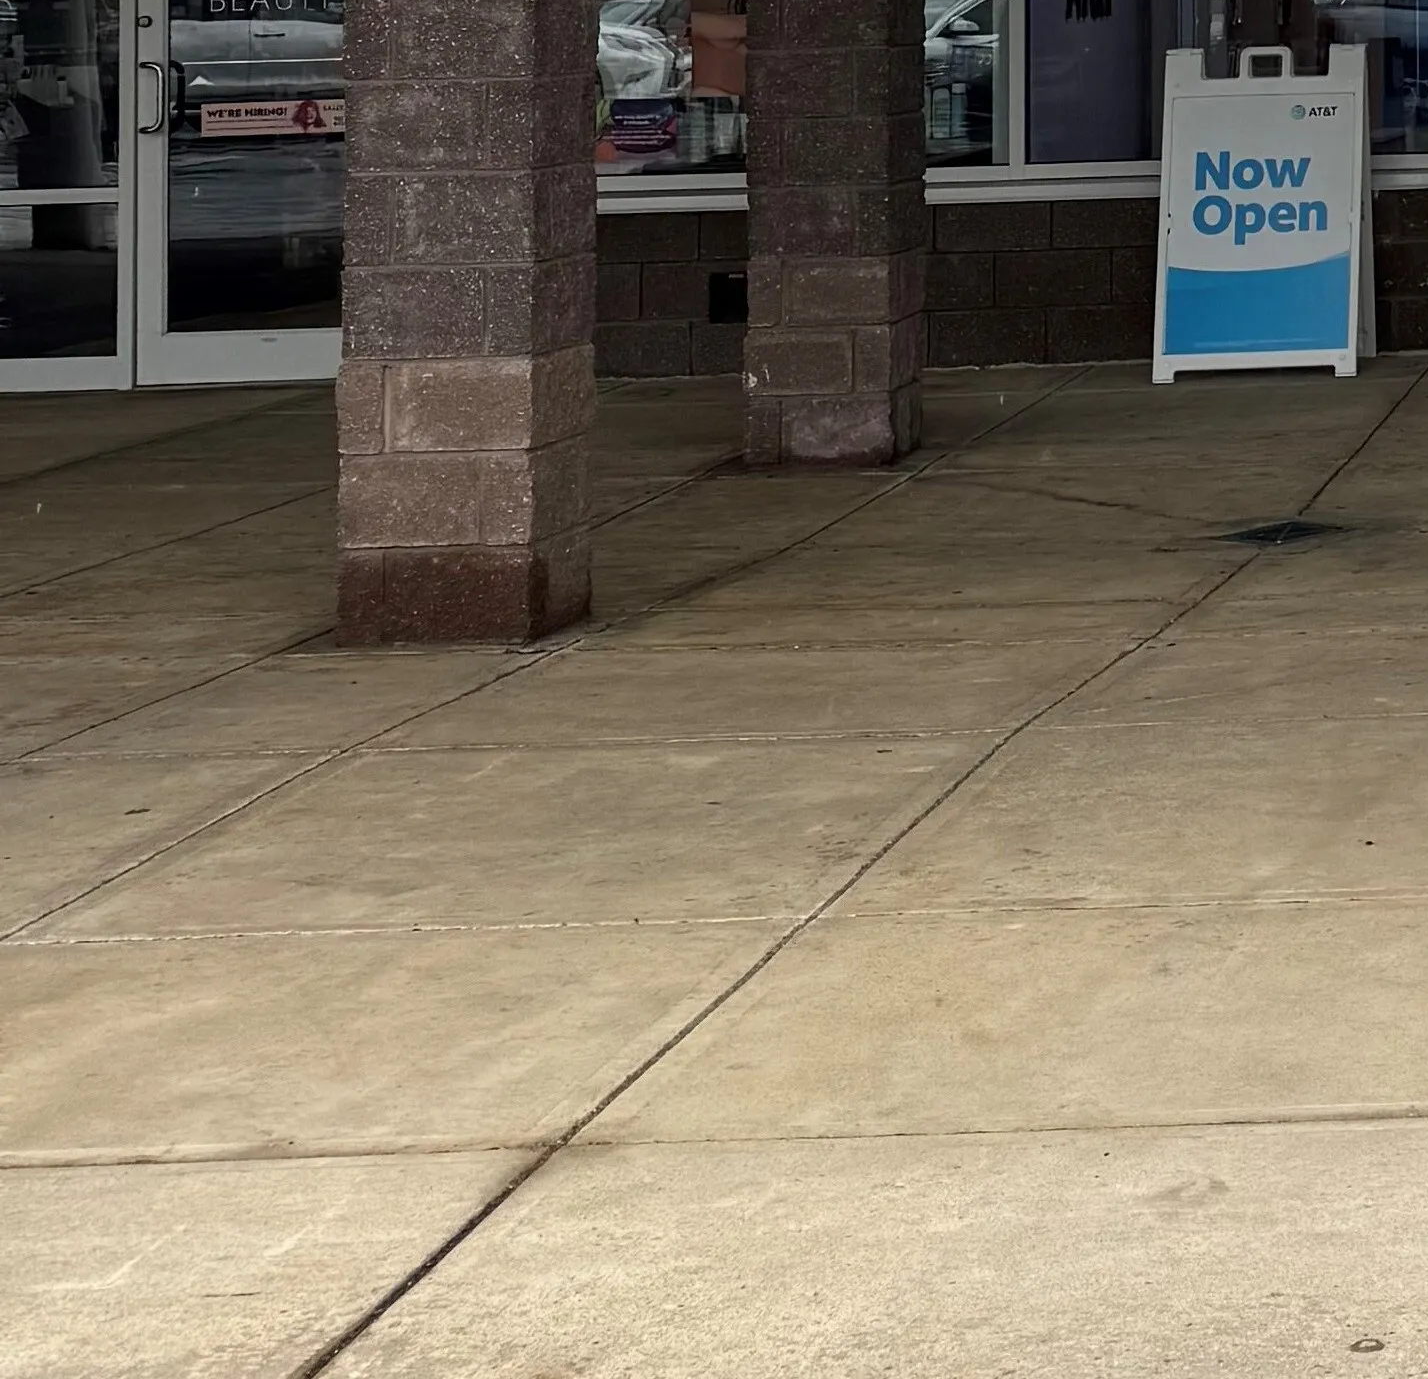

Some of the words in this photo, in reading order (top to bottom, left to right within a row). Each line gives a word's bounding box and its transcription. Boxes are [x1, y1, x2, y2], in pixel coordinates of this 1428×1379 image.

[206, 108, 242, 118] WE'RE
[244, 106, 288, 117] HIRING!
[1308, 105, 1338, 118] AT&T
[1194, 151, 1311, 191] Now
[1192, 195, 1328, 246] Open
